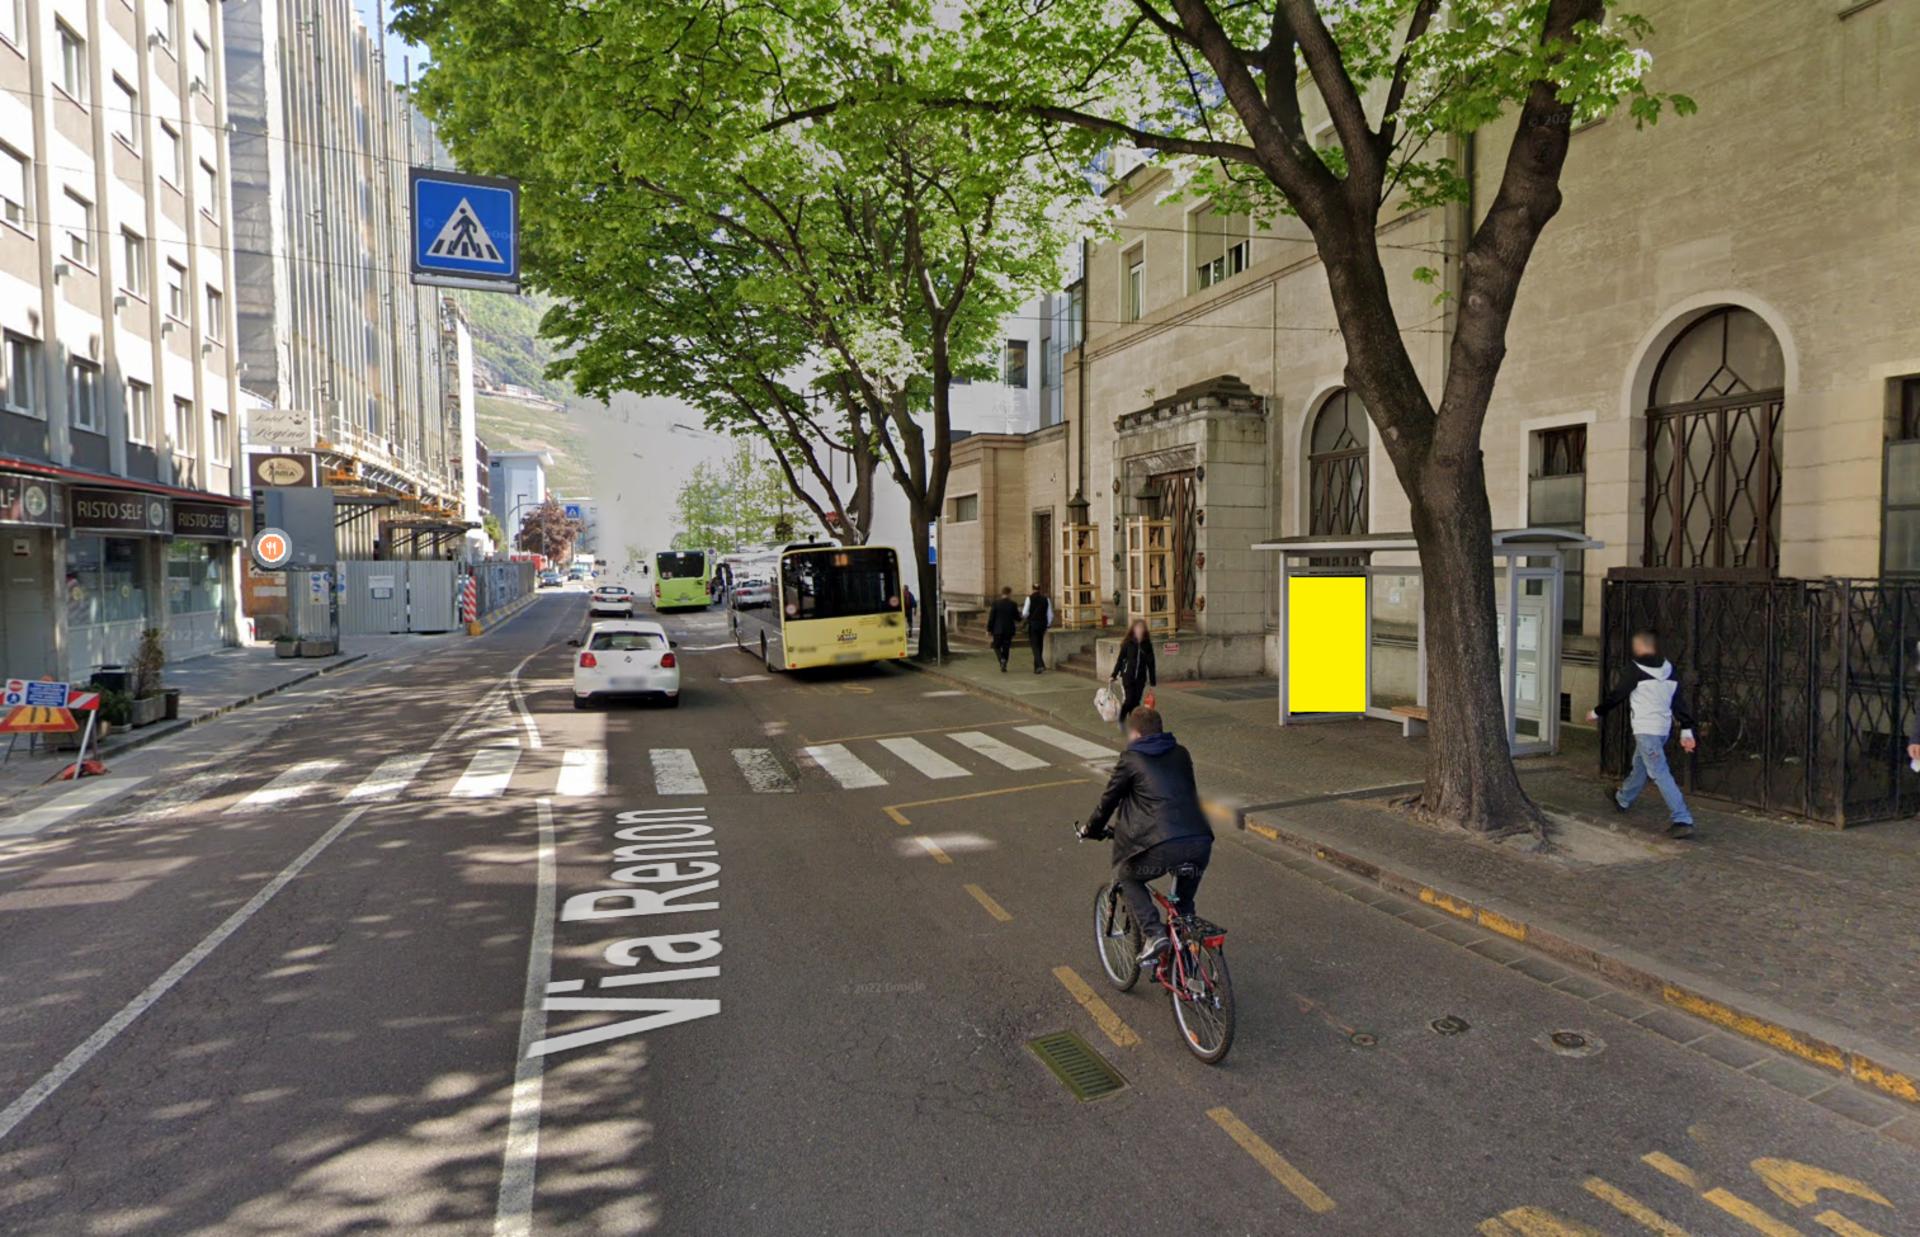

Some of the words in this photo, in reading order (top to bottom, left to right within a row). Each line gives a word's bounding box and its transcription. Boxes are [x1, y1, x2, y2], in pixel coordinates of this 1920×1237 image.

[77, 500, 119, 520] RISTO
[119, 503, 143, 521] SELF
[177, 511, 209, 528] RISTO
[209, 514, 226, 529] SELF
[560, 806, 722, 922] Renon
[526, 928, 723, 1060] Via
